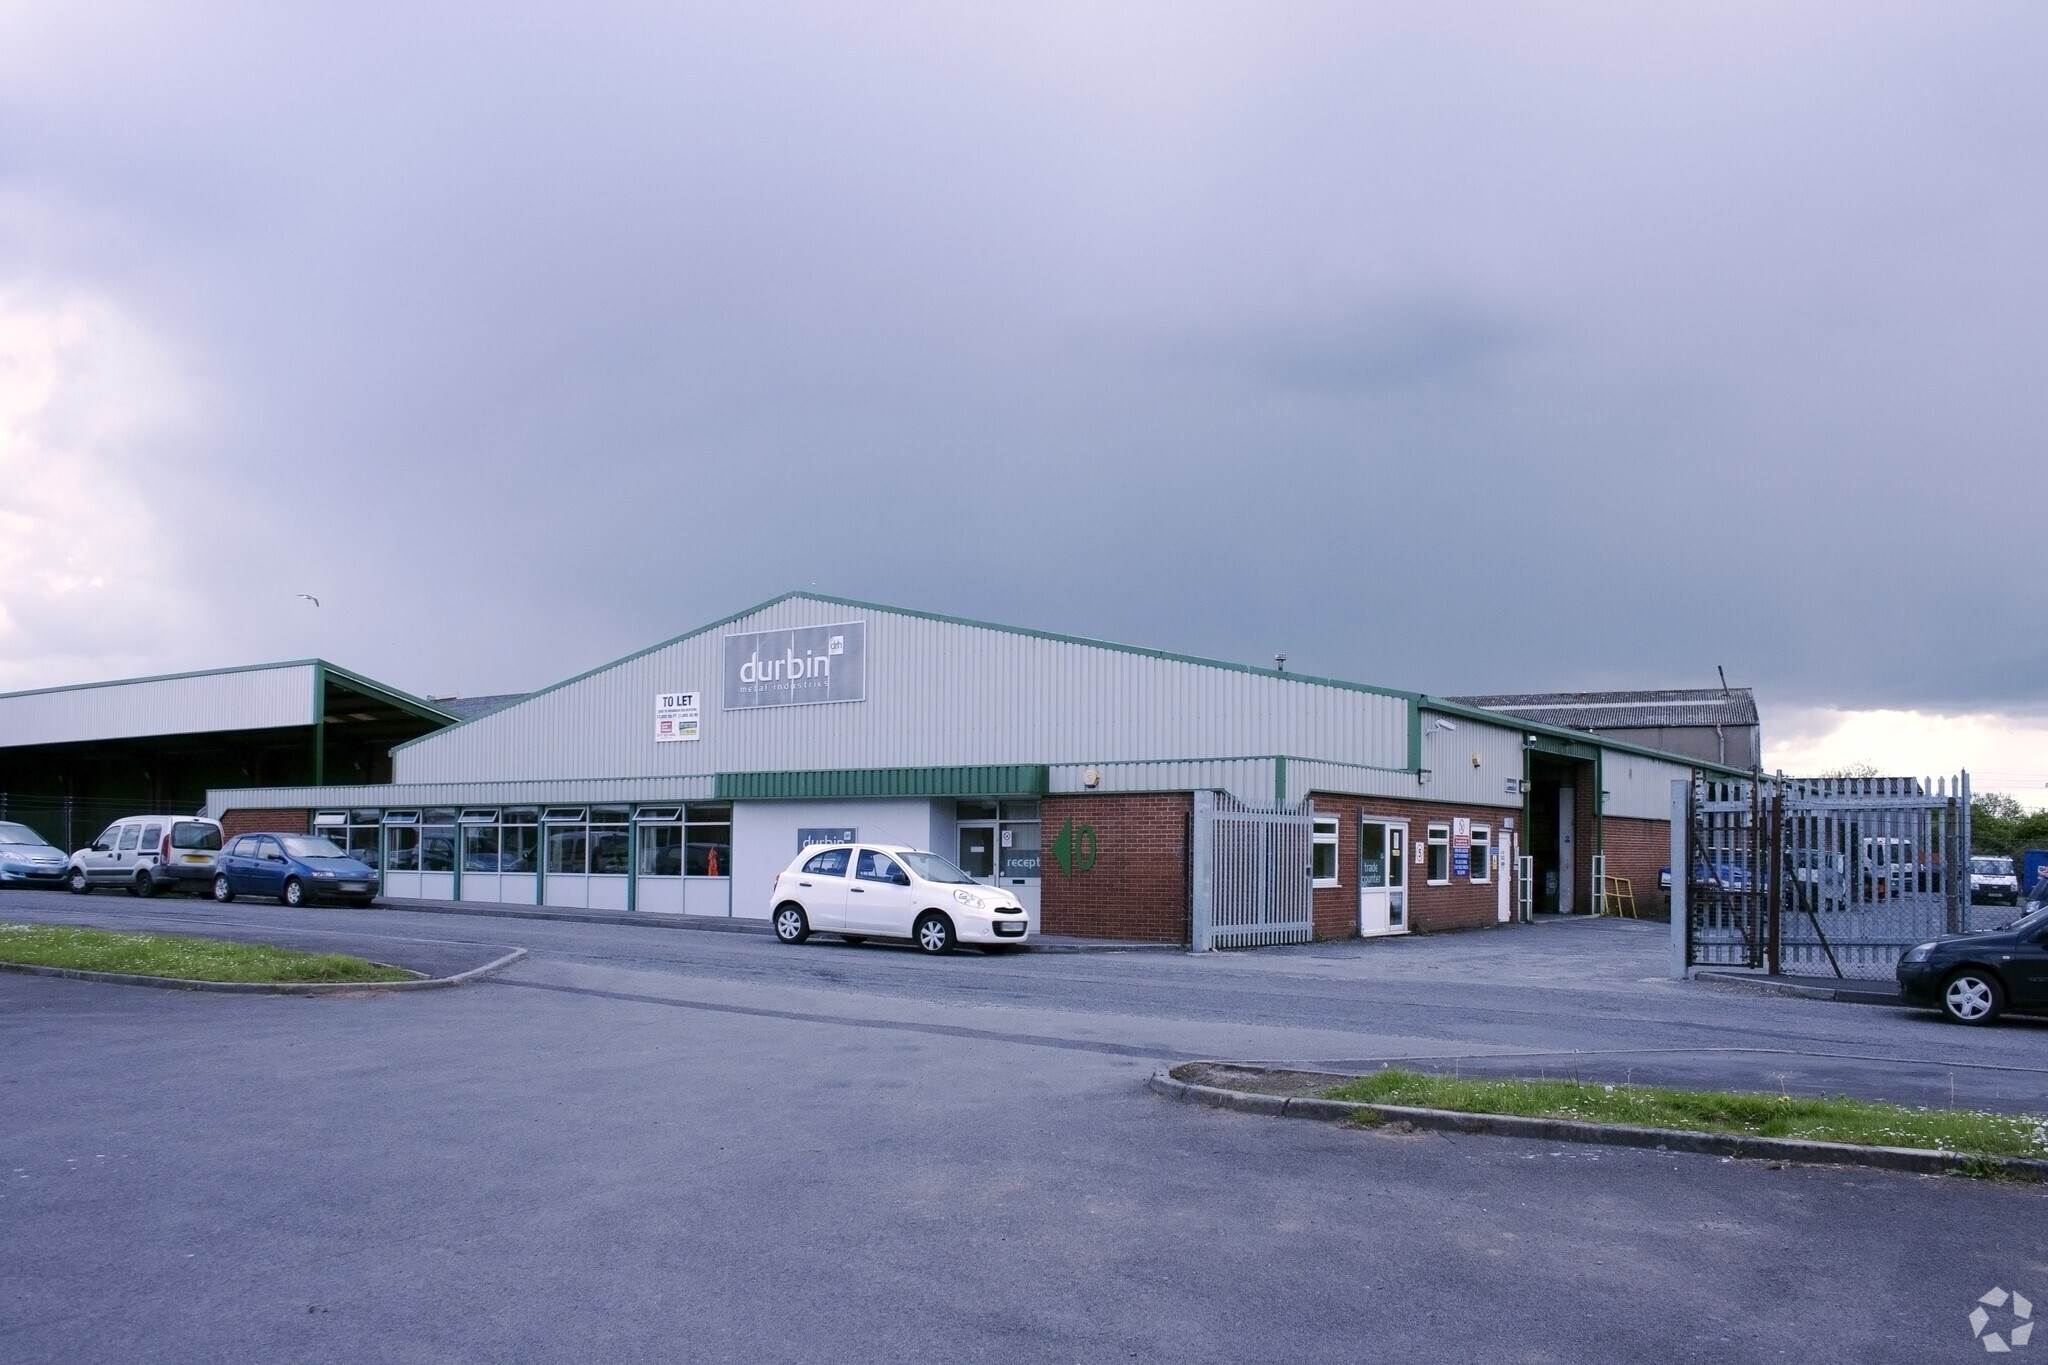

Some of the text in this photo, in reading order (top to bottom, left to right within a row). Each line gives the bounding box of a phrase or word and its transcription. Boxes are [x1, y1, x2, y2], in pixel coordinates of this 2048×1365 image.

[740, 648, 829, 683] durbin
[740, 681, 828, 693] metal industries
[663, 695, 692, 707] TO LET
[1007, 857, 1041, 869] recept
[1364, 862, 1378, 872] trade
[1361, 873, 1381, 884] counter
